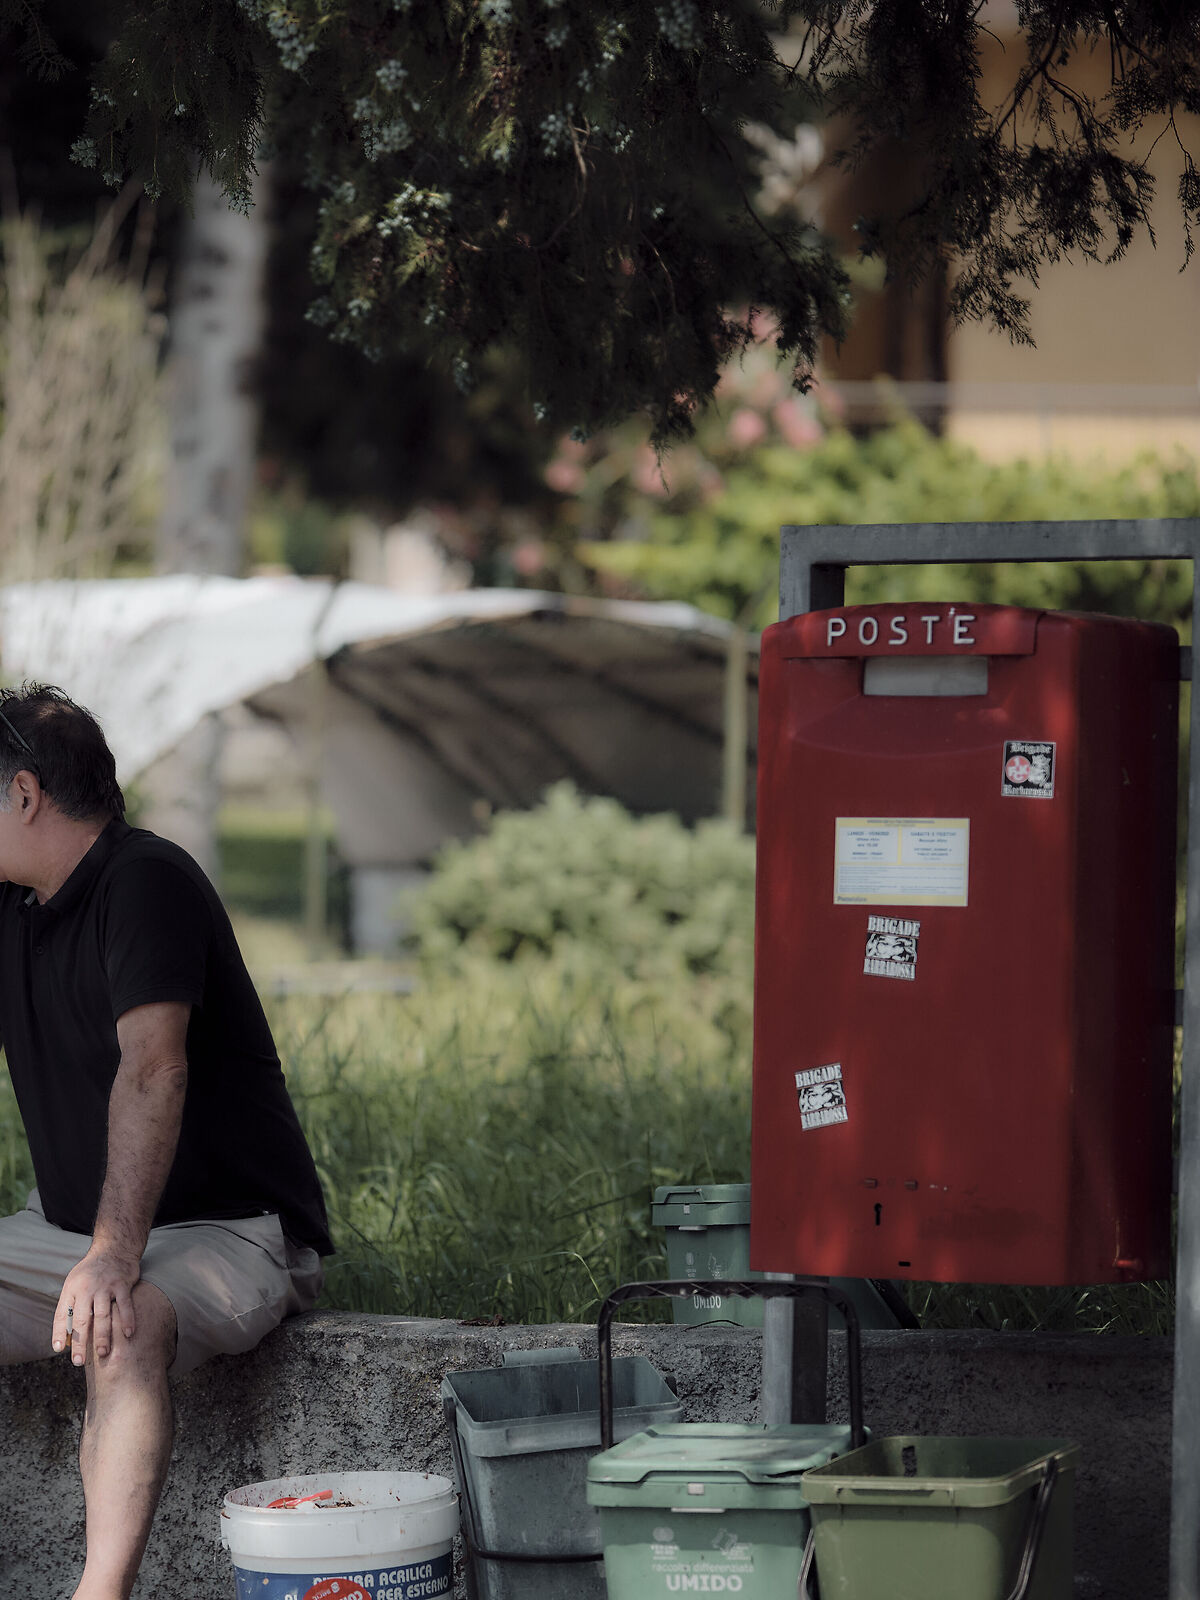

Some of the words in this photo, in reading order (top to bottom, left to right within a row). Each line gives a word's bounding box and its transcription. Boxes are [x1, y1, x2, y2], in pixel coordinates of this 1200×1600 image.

[828, 615, 975, 646] POSTE
[867, 917, 921, 937] BRIGADE
[795, 1065, 842, 1088] BRIGADE
[693, 1295, 721, 1309] UMIDO
[379, 1564, 432, 1586] ACRILICA
[665, 1574, 743, 1592] UMIDO
[406, 1575, 449, 1598] ESTERNO
